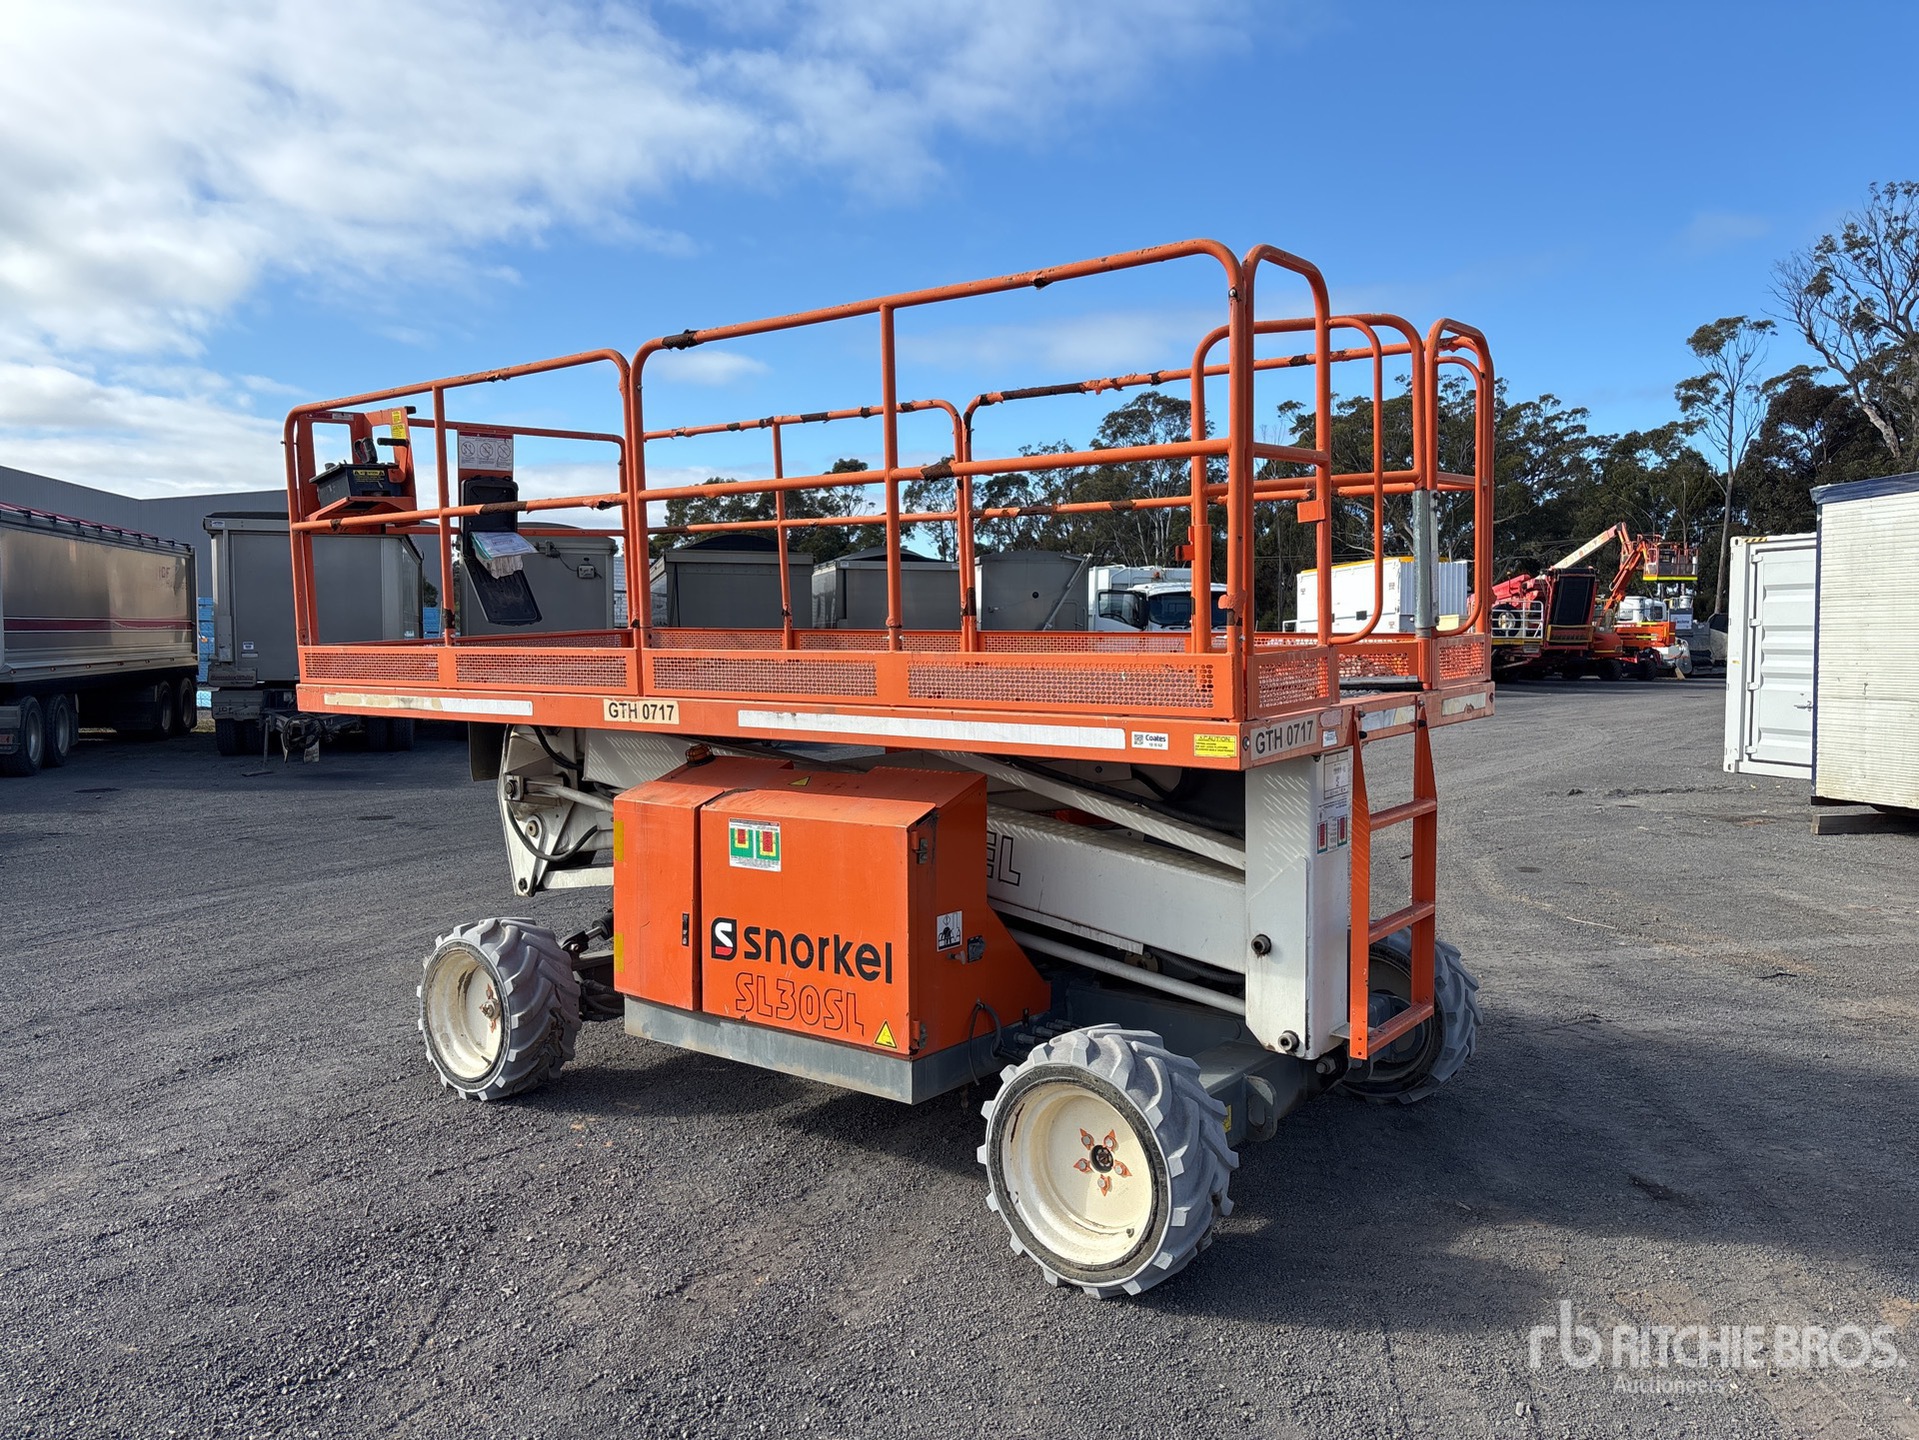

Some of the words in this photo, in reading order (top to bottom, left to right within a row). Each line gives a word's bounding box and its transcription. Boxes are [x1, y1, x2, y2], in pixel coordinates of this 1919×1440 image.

[608, 701, 638, 719] GTH
[642, 703, 675, 722] 0717
[1145, 733, 1167, 743] Coates
[1203, 735, 1231, 743] CAUTION
[1255, 727, 1283, 755] GTH
[1287, 719, 1314, 747] 0717
[744, 925, 893, 984] snorkel
[735, 971, 865, 1036] SL30SL
